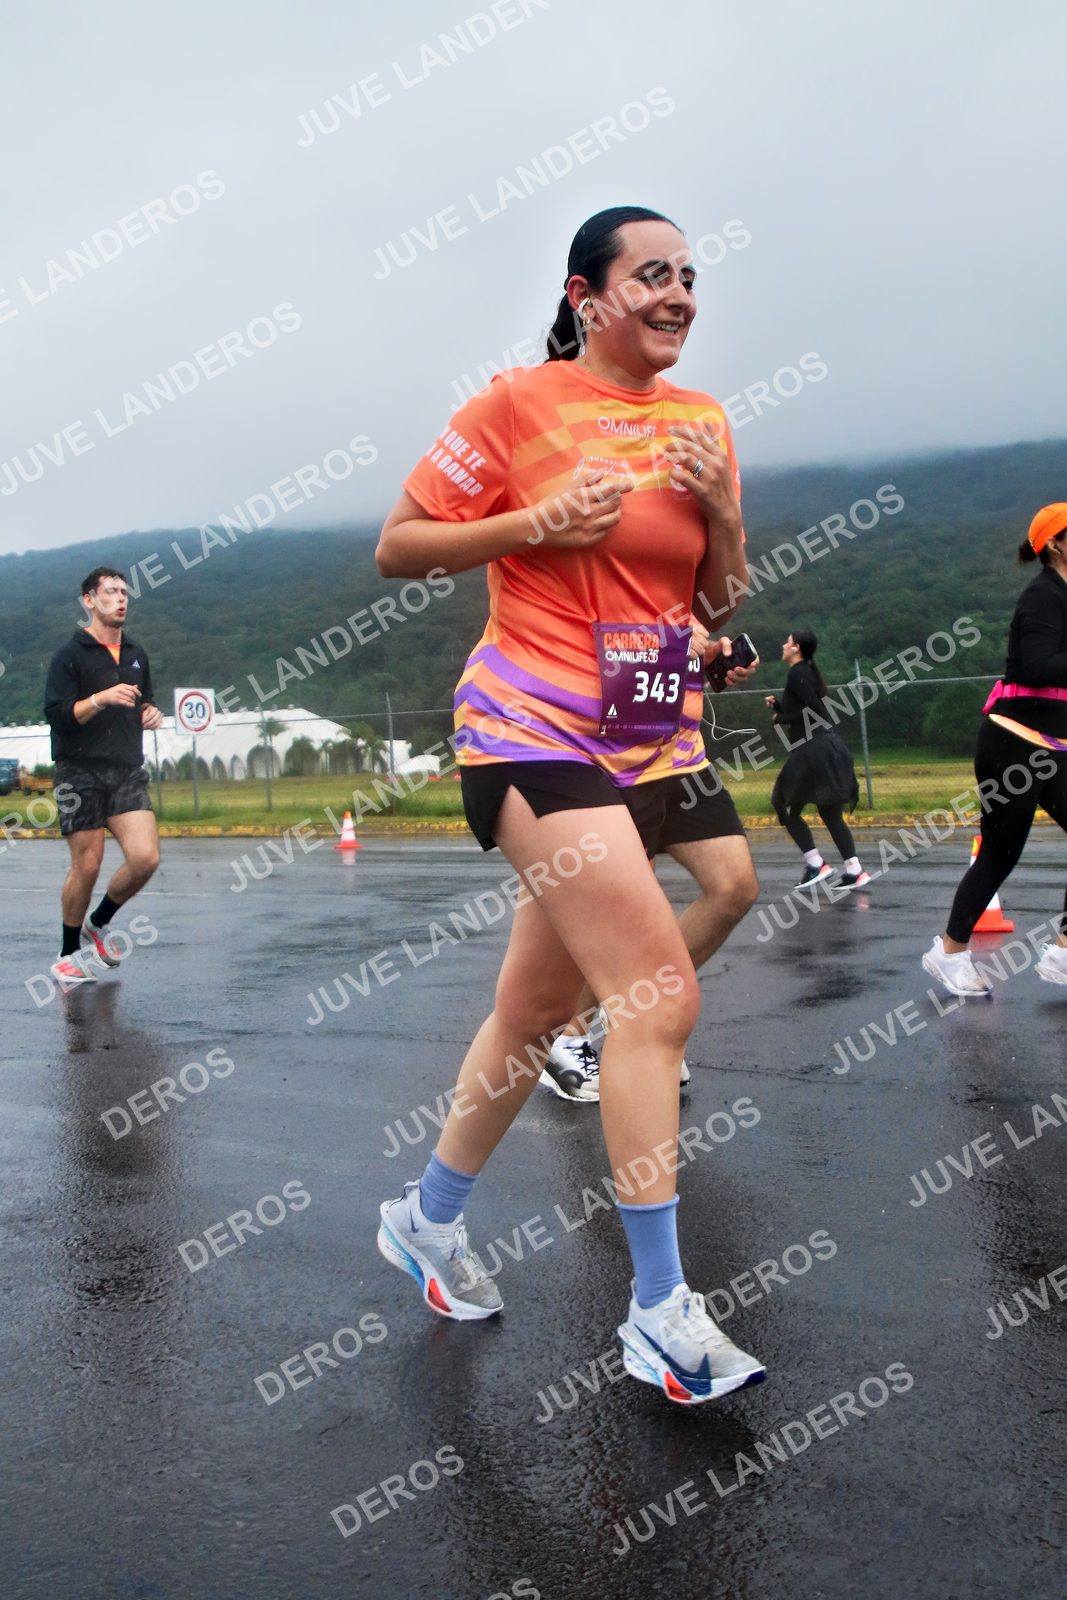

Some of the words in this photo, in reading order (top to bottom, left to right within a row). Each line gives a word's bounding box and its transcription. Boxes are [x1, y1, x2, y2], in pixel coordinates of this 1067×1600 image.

[598, 416, 656, 440] OMNILIFE
[444, 430, 471, 458] QUE
[464, 450, 487, 472] TE
[437, 455, 484, 497] GANAR
[603, 632, 660, 650] CARRERA
[632, 670, 680, 703] 343
[184, 702, 206, 719] 30
